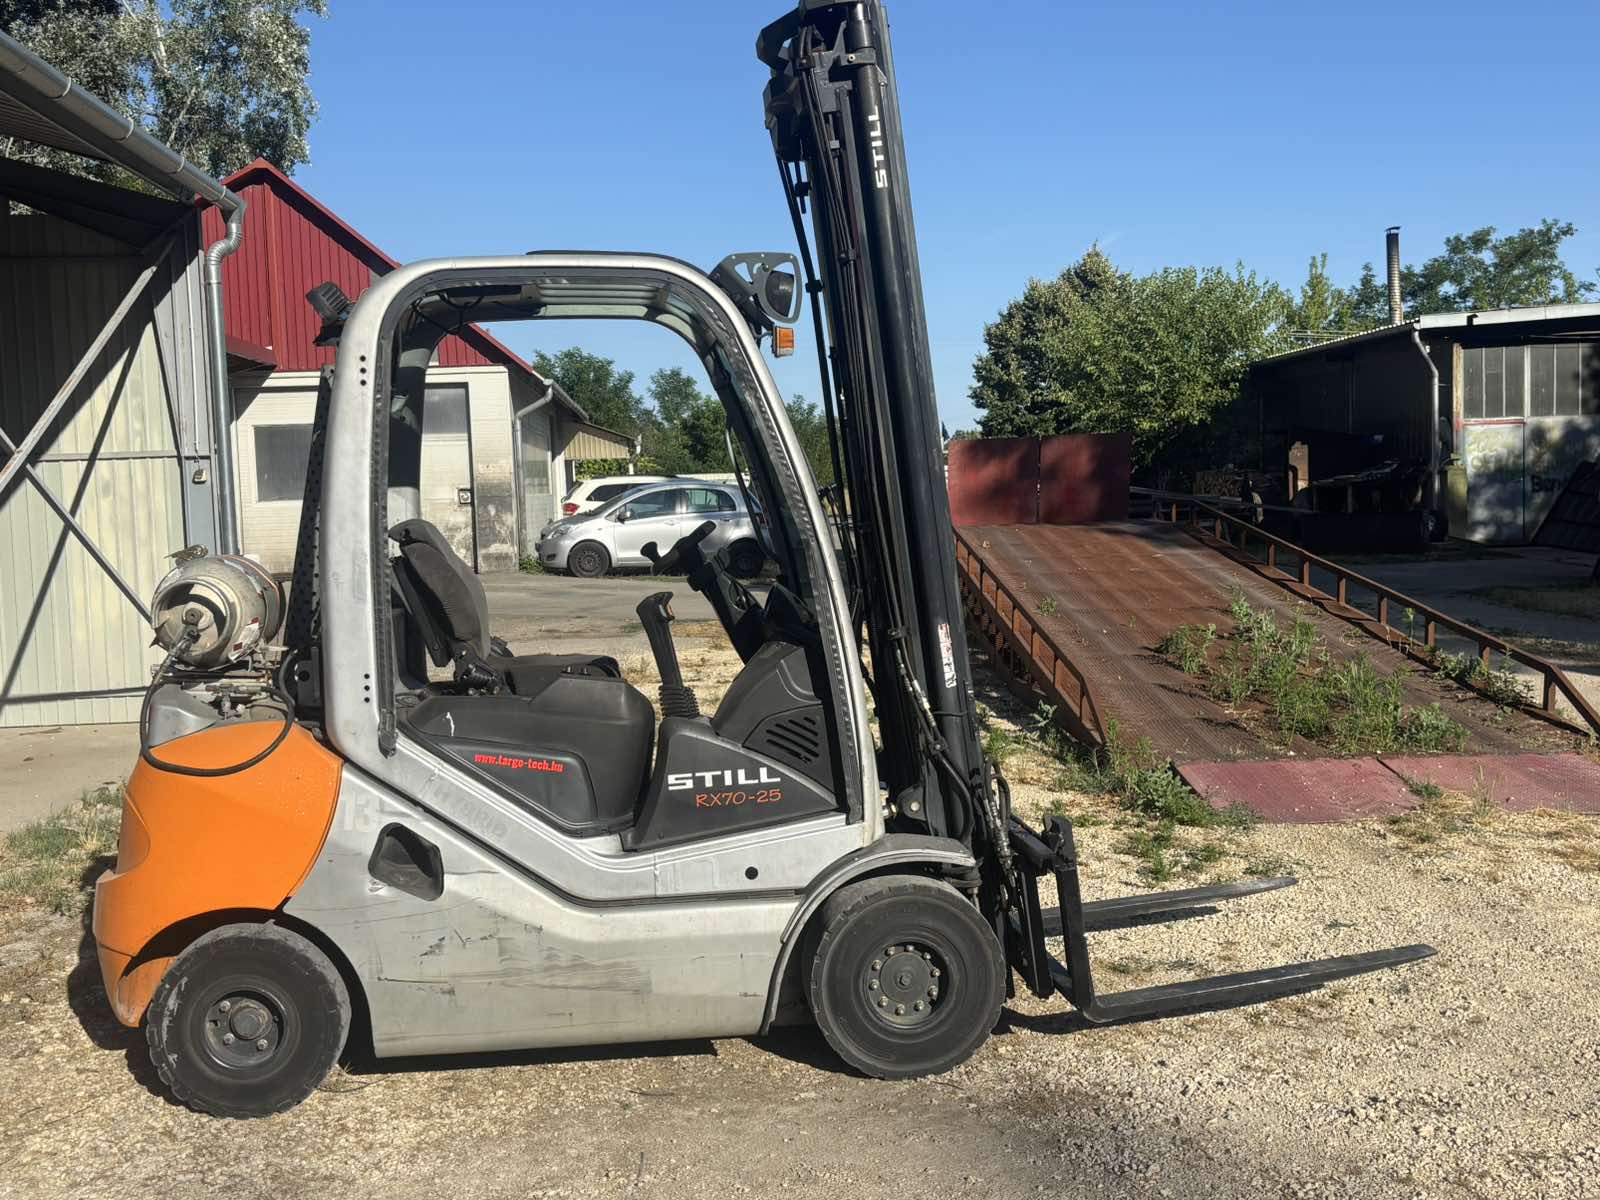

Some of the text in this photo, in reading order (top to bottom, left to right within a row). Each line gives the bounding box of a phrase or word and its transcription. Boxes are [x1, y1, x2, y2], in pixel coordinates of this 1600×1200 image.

[868, 105, 888, 188] STILL
[474, 754, 564, 773] www.targo-tech.hu
[667, 767, 781, 790] STILL
[695, 789, 781, 807] RX70-25
